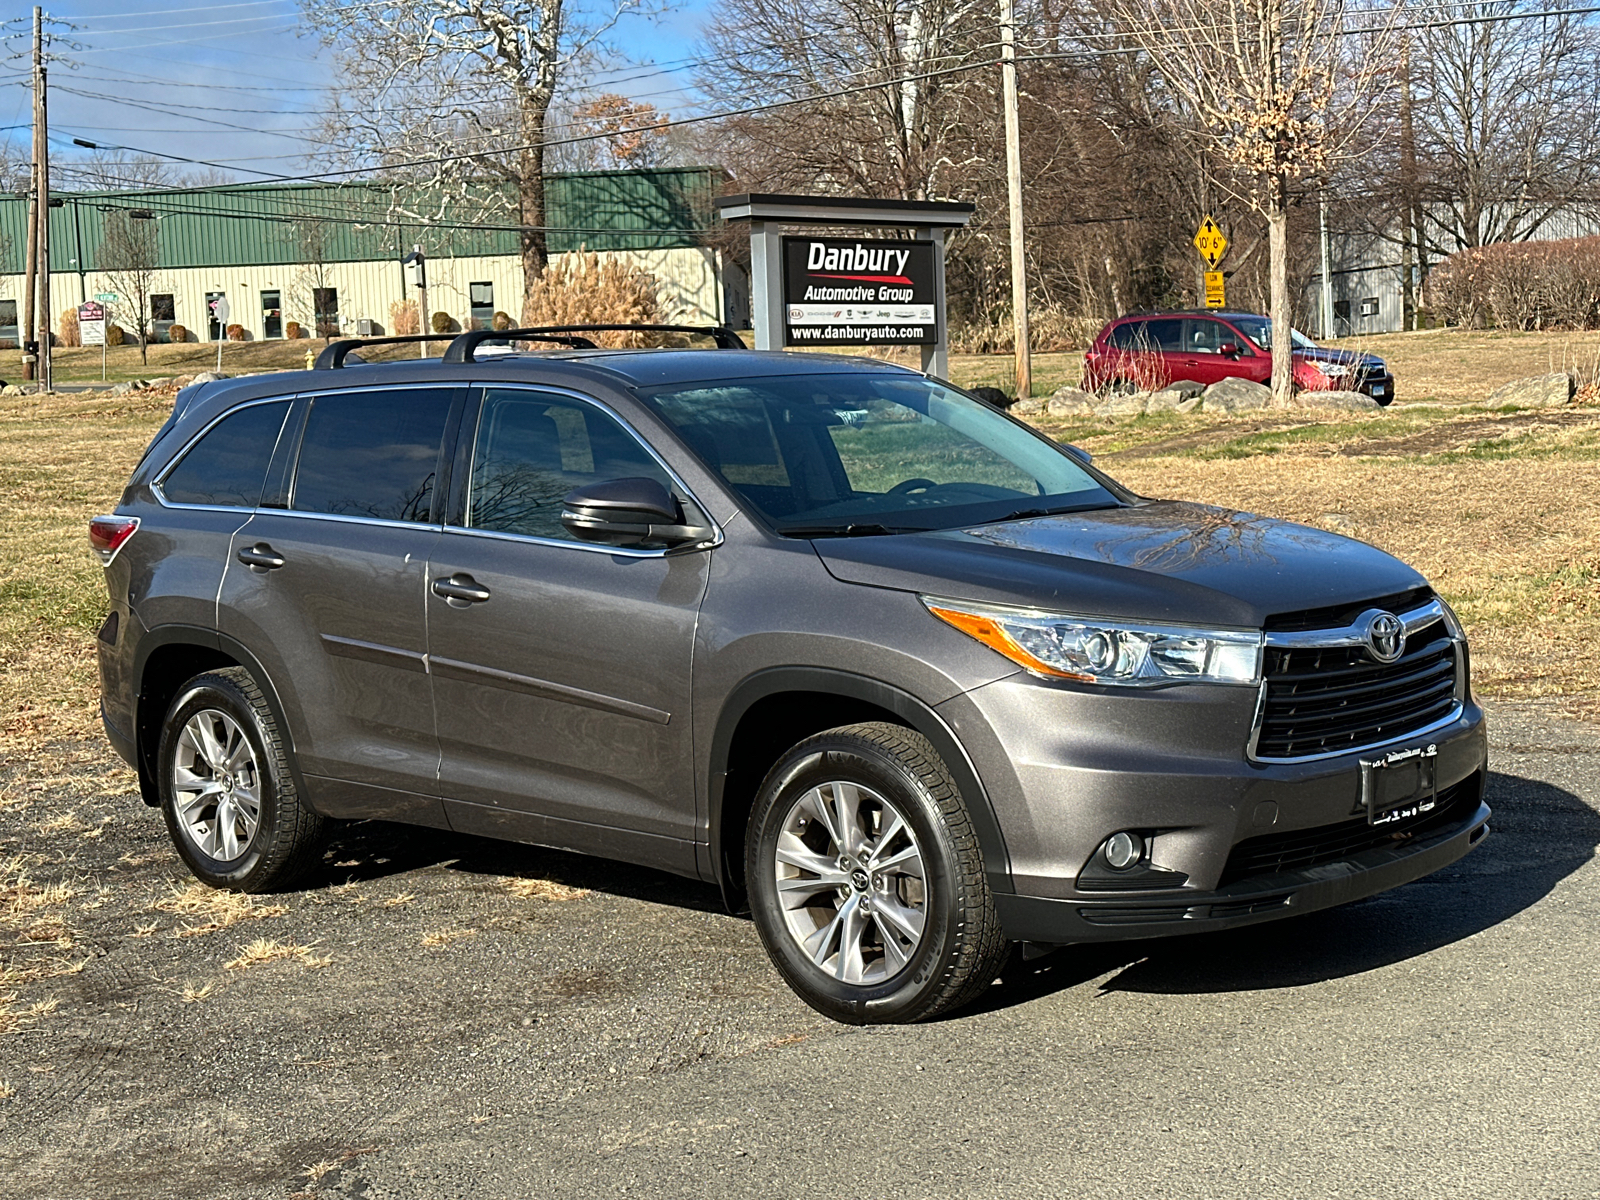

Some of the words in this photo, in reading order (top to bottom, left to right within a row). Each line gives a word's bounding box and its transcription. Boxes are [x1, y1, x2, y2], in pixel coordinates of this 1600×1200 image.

[807, 242, 910, 276] Danbury
[804, 285, 875, 301] Automotive
[878, 286, 914, 303] Group
[876, 310, 891, 319] Jeep
[791, 325, 924, 341] www.danburyauto.com
